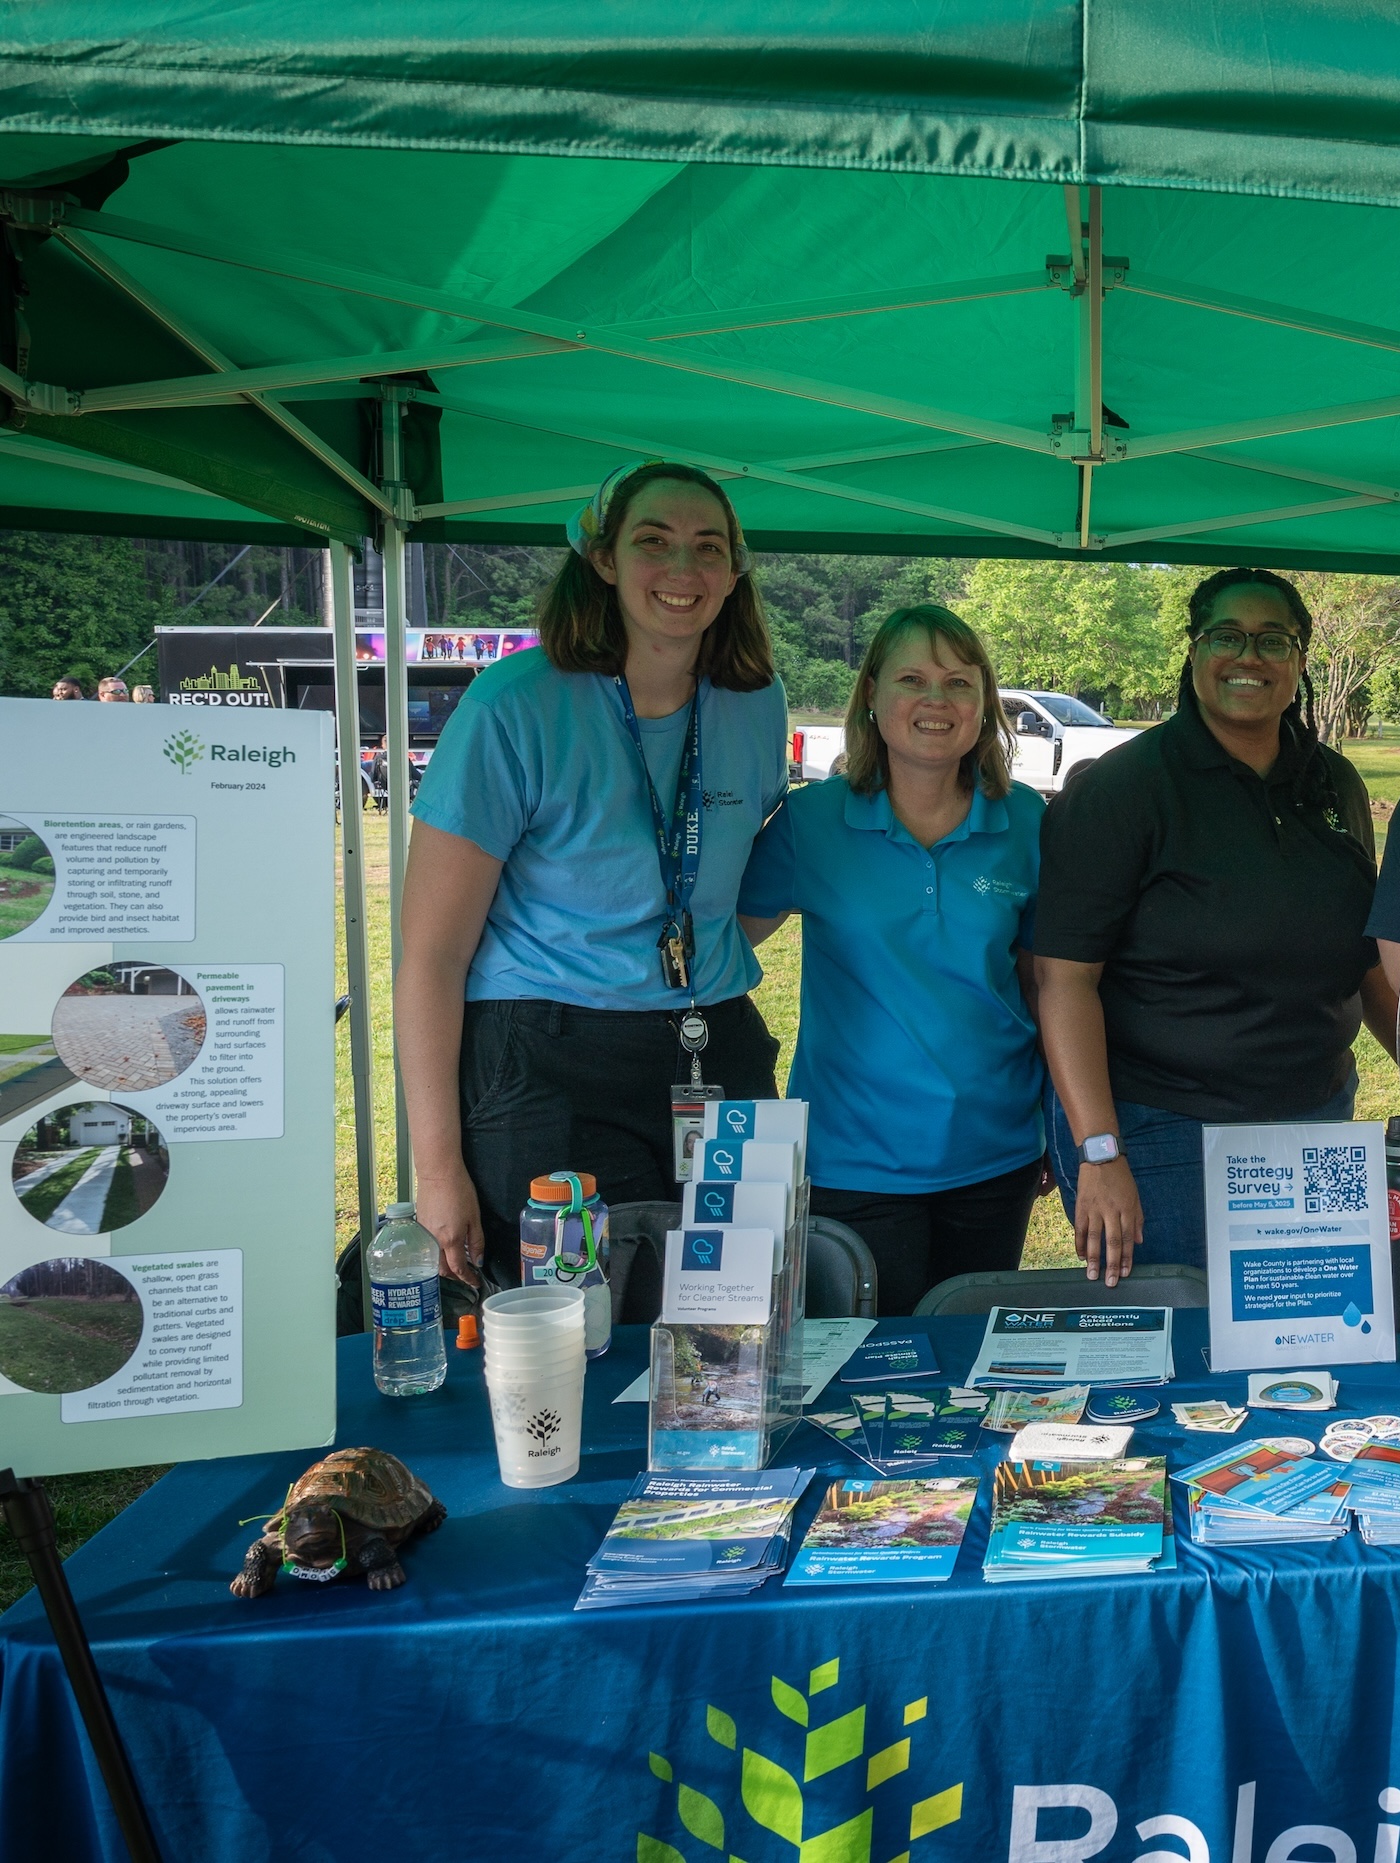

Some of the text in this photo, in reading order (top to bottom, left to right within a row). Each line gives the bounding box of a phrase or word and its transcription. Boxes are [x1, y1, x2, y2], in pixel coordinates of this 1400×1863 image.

[169, 693, 269, 706] REC'D OUT!
[211, 744, 296, 768] Raleigh
[211, 782, 244, 791] February
[44, 820, 96, 828] Bioretention
[153, 822, 187, 831] gardens,
[70, 833, 114, 842] engineered
[116, 833, 157, 842] landscape
[61, 843, 95, 852] features
[66, 856, 96, 864] volume
[114, 856, 149, 865] pollution
[151, 857, 161, 866] by
[67, 868, 106, 877] capturing
[124, 868, 169, 877] temporarily
[67, 880, 96, 889] storing
[107, 879, 148, 889] infiltrating
[67, 891, 98, 901] through
[100, 891, 117, 899] soil,
[63, 903, 108, 912] vegetation.
[110, 902, 129, 912] They
[58, 914, 89, 923] provide
[68, 926, 105, 935] improved
[1226, 1155, 1266, 1165] Take the
[1227, 1166, 1294, 1180] Strategy
[1227, 1181, 1280, 1196] Survey
[1274, 1199, 1291, 1208] 2025
[1264, 1226, 1342, 1236] wake.gov/OneWater
[1293, 1259, 1324, 1267] partnering
[1269, 1274, 1305, 1282] sustainable
[371, 1287, 385, 1297] EER
[388, 1286, 420, 1296] HYDRATE
[680, 1284, 754, 1293] Working Together
[372, 1295, 386, 1307] ARK
[1273, 1294, 1290, 1302] your
[1314, 1291, 1342, 1300] prioritize
[389, 1299, 421, 1308] REWARDS!
[1245, 1302, 1275, 1310] strategies
[859, 1339, 913, 1348] PASSPOR
[528, 1446, 561, 1457] Raleigh
